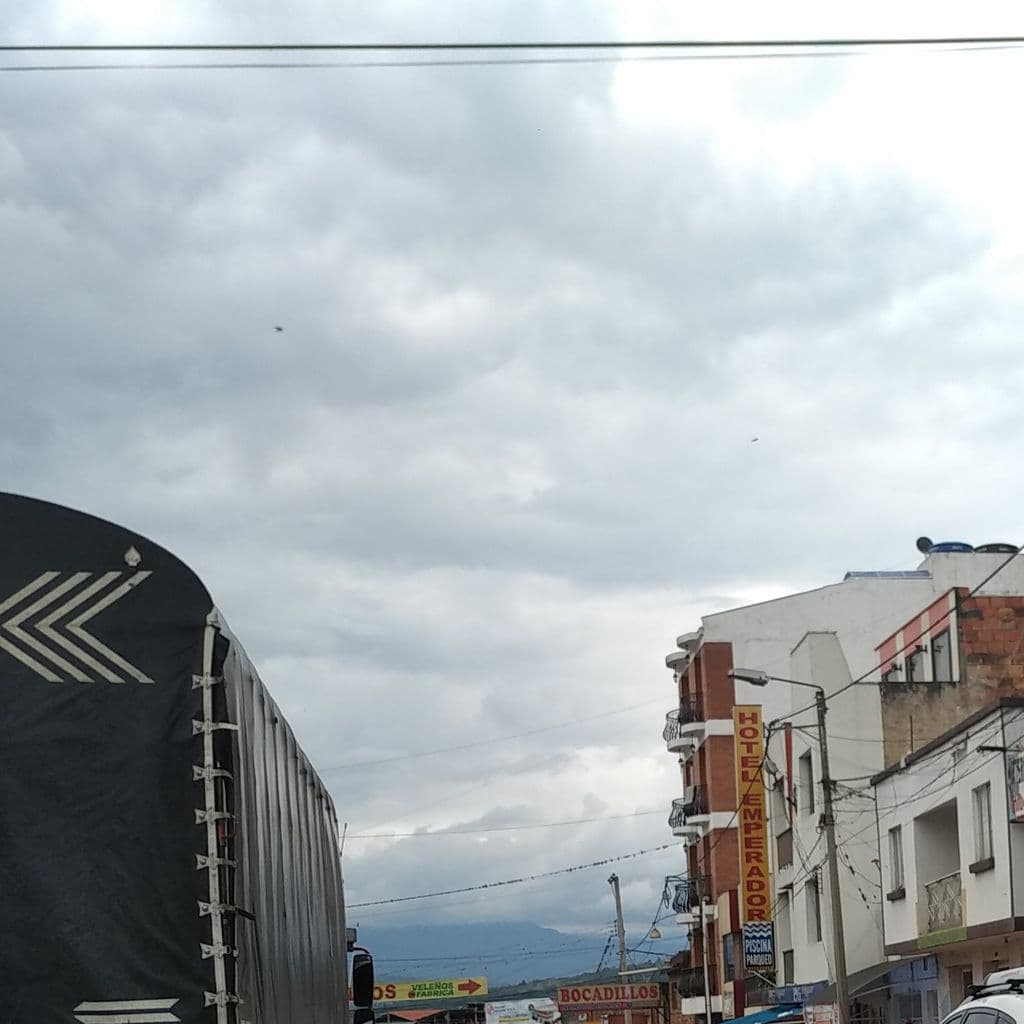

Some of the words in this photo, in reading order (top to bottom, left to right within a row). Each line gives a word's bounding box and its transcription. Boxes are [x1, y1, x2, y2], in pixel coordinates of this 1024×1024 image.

[738, 711, 761, 783] HOTEL
[741, 794, 765, 921] EMPERADOR
[745, 938, 772, 953] PISCINA
[559, 985, 658, 1003] BOCADILLOS
